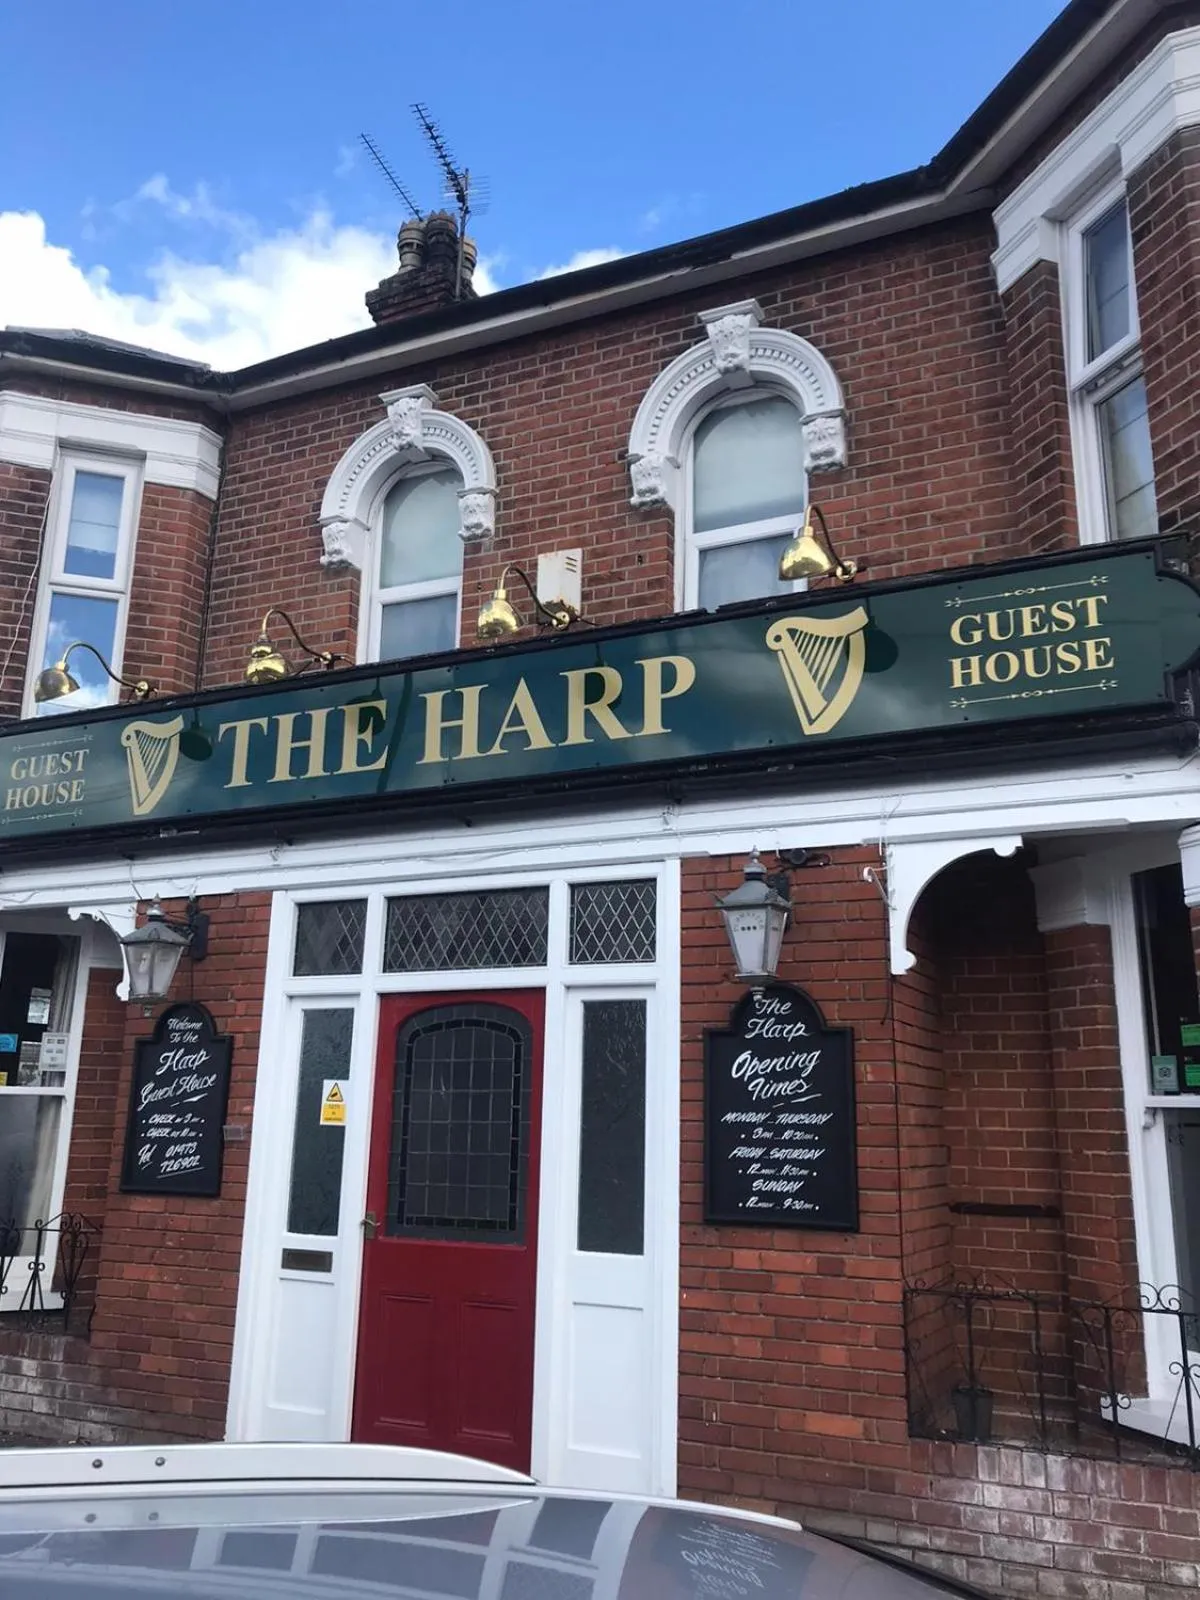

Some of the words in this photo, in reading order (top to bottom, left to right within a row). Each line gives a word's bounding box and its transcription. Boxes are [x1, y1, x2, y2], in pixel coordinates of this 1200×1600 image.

[949, 594, 1109, 647] GUEST
[947, 637, 1115, 689] HOUSE
[218, 698, 390, 790] THE
[416, 655, 697, 766] HARP
[11, 748, 90, 781] GUEST
[4, 778, 85, 811] HOUSE
[755, 996, 792, 1015] The
[167, 1015, 203, 1031] Welcome
[744, 1017, 810, 1042] Harp
[155, 1047, 211, 1076] Harp
[731, 1049, 822, 1082] Opening
[137, 1077, 178, 1111] Guest
[176, 1073, 217, 1096] House
[748, 1077, 813, 1102] Times
[148, 1113, 176, 1125] CHECK
[720, 1112, 771, 1125] MONDAY
[774, 1112, 834, 1125] THURSDAY
[146, 1127, 172, 1139] CHECK
[138, 1143, 158, 1165] Tel
[165, 1142, 198, 1158] 01473
[160, 1155, 201, 1173] 726902
[728, 1146, 767, 1159] FRIDAY
[769, 1147, 826, 1160] SATURDAY
[752, 1179, 805, 1193] SUNDAY
